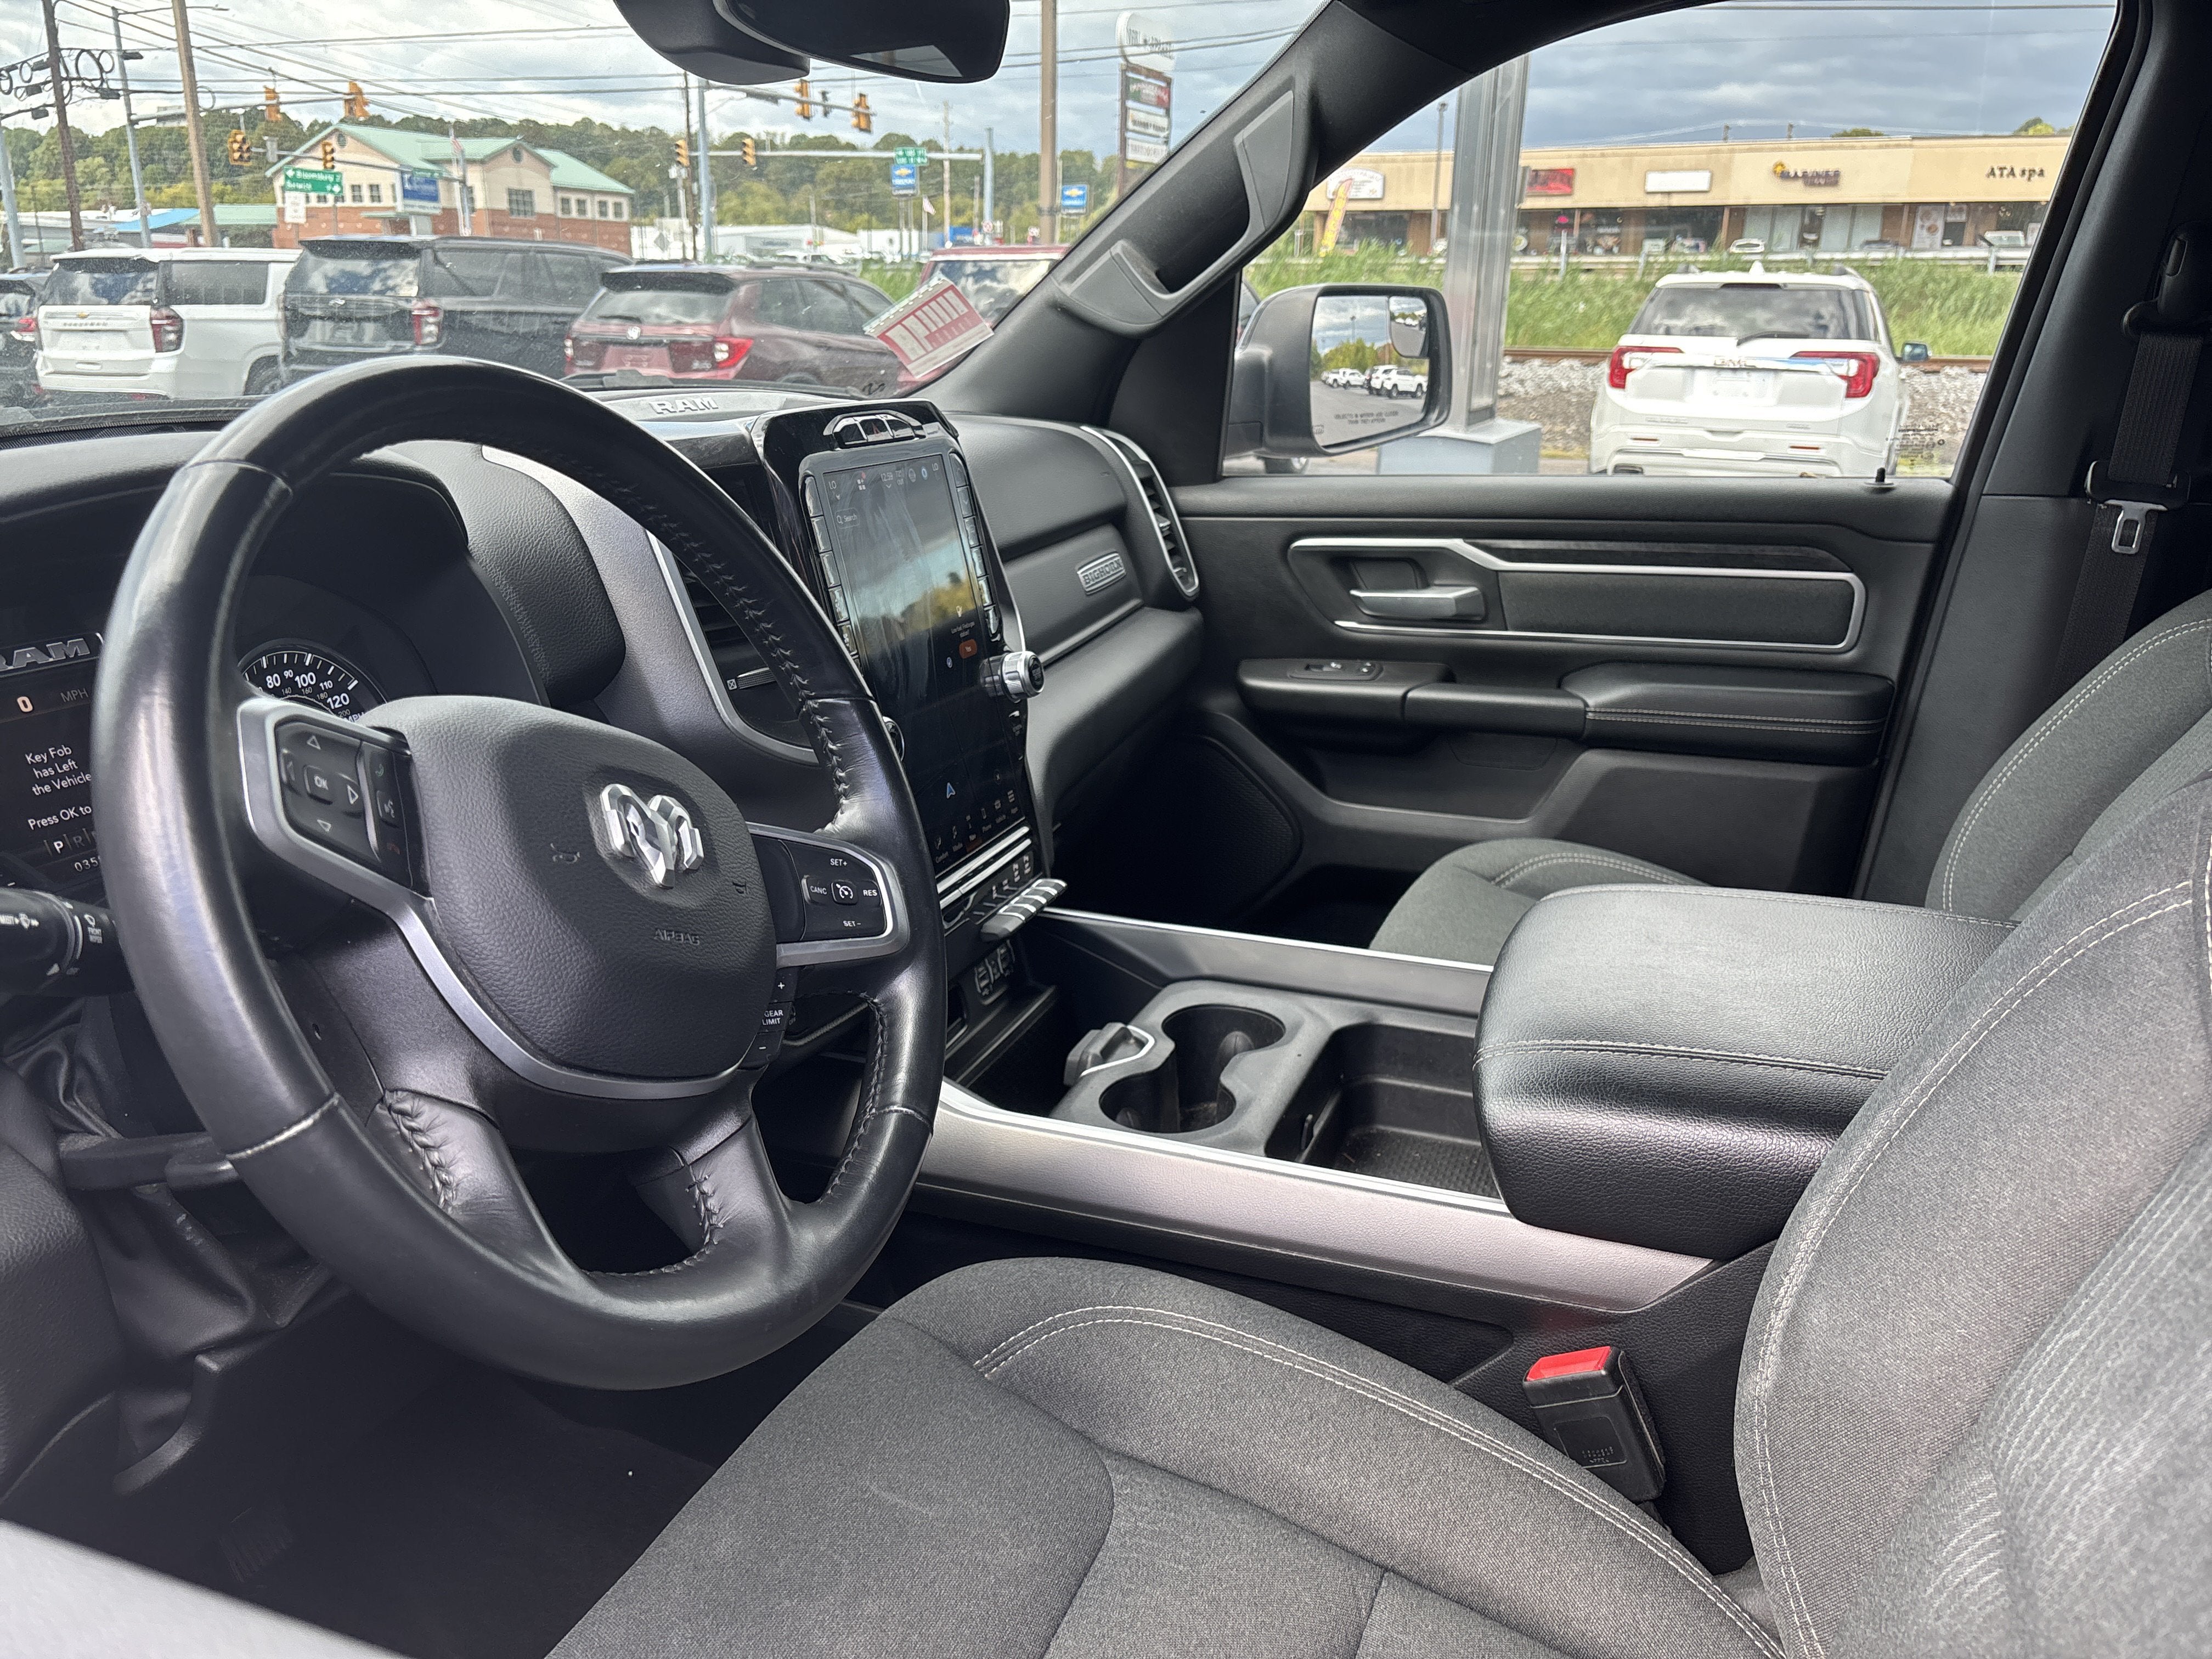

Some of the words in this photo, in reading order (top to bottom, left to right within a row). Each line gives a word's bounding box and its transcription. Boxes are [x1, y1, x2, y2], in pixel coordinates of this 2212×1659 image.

[1985, 165, 2017, 178] ATA
[2019, 168, 2045, 182] spa
[648, 397, 719, 414] RAM
[828, 480, 837, 490] LO
[843, 513, 858, 522] Search
[266, 673, 281, 689] 80
[284, 669, 294, 679] 90
[294, 672, 316, 688] 100
[281, 686, 292, 695] 140
[302, 686, 313, 695] 160
[319, 680, 333, 691] 110
[16, 696, 33, 712] 0
[60, 688, 89, 703] MPH
[326, 693, 350, 709] 120
[338, 709, 351, 717] 200
[25, 753, 47, 764] Key
[48, 744, 72, 759] Fob
[33, 768, 55, 778] has
[55, 759, 78, 773] Left
[32, 783, 52, 795] the
[51, 772, 92, 789] Vehicle
[314, 775, 329, 791] OK
[27, 815, 59, 831] Press
[60, 806, 80, 820] OK
[79, 806, 92, 815] to
[53, 840, 64, 854] P
[73, 836, 85, 848] R
[74, 856, 101, 872] 035
[810, 885, 827, 895] CANC
[653, 928, 700, 946] AIRBAG
[764, 1009, 783, 1018] GEAR
